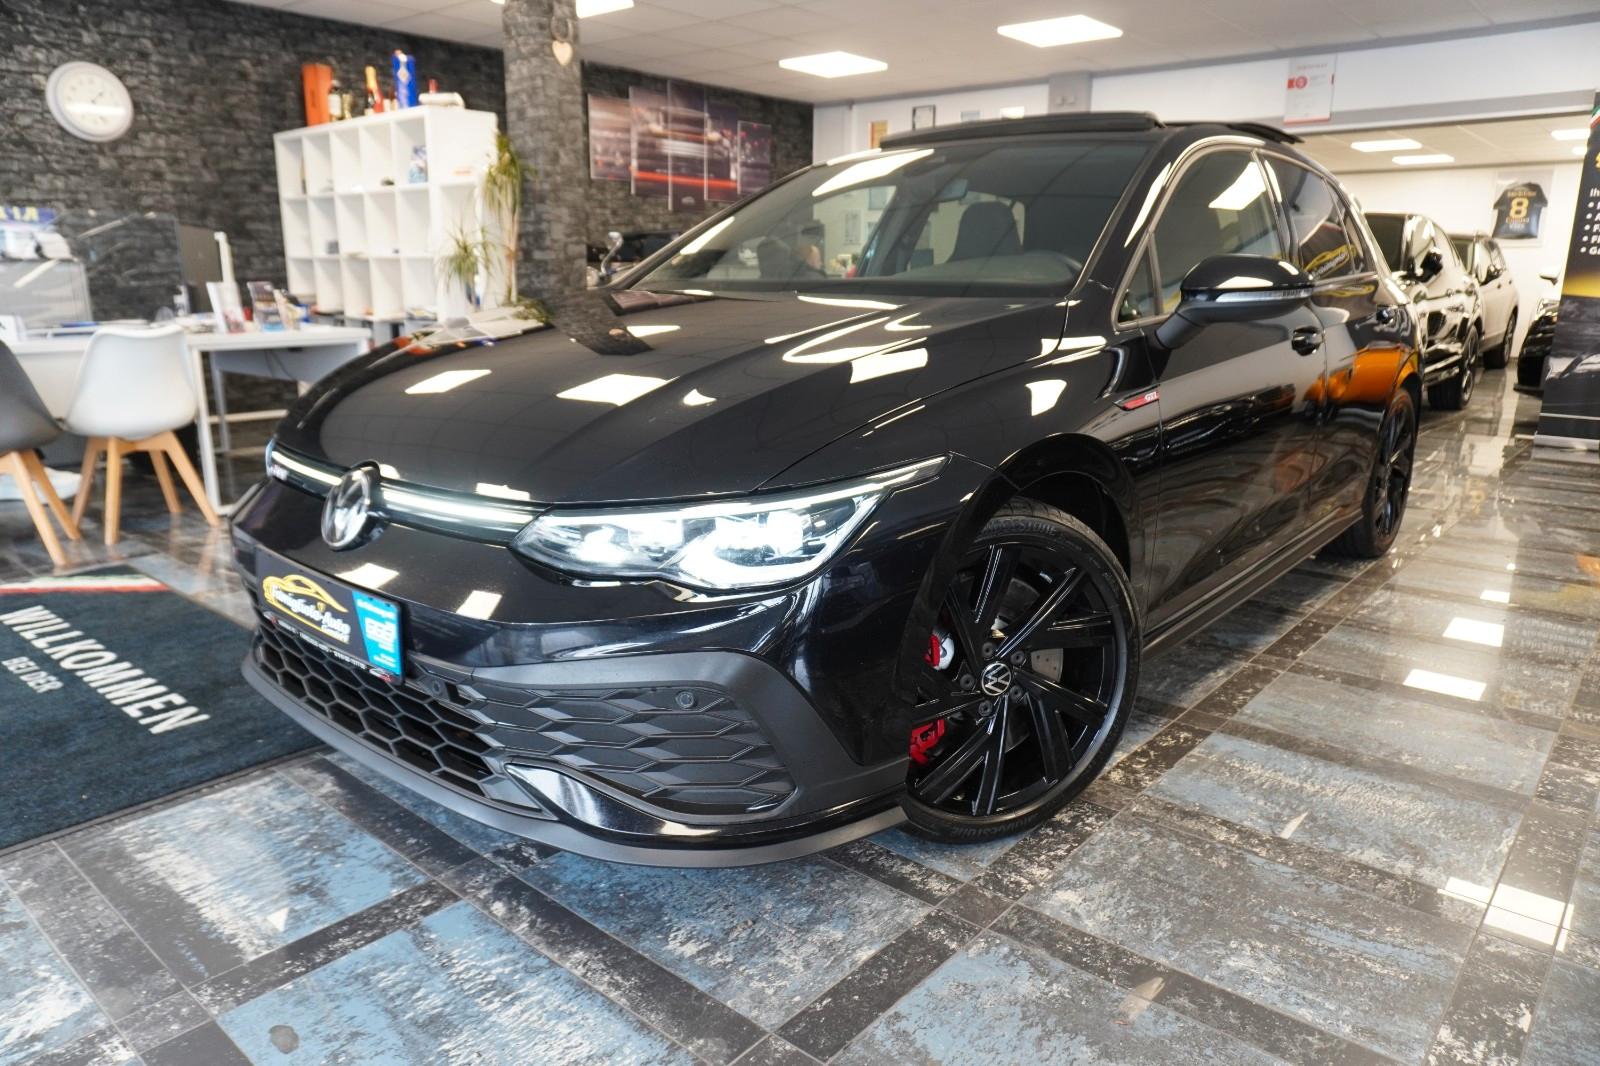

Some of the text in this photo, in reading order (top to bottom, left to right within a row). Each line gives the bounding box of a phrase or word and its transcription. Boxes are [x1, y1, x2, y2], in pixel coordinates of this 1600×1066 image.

[1509, 197, 1529, 219] 8
[0, 605, 210, 734] WILLKOMMEN
[1, 656, 63, 693] BEI DER
